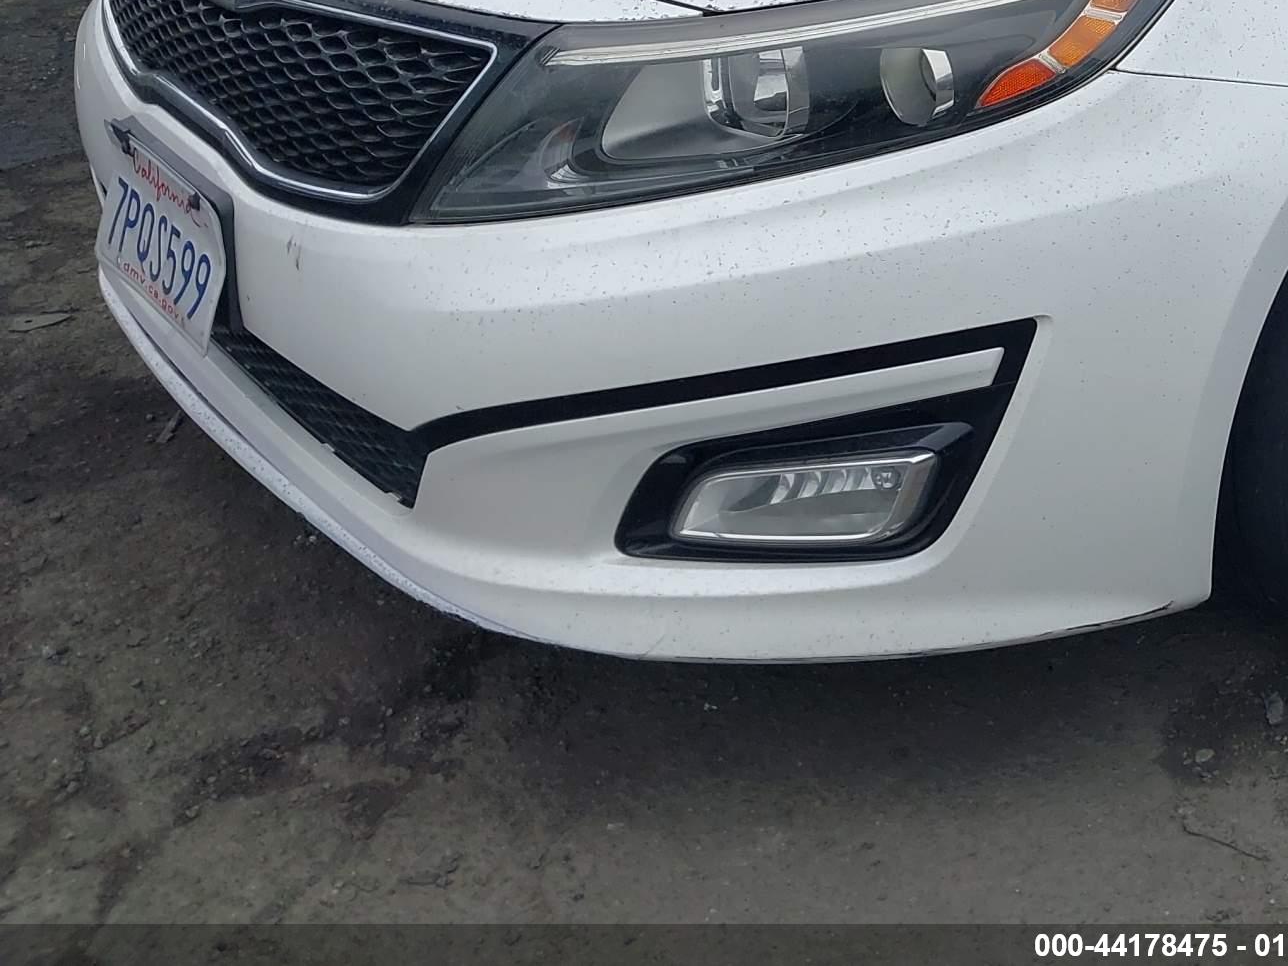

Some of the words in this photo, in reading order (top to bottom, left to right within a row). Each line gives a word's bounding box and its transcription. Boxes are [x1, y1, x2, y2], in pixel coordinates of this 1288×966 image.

[131, 147, 204, 229] California
[107, 176, 212, 320] 7PQS599
[122, 261, 180, 322] dmv.ca.gov
